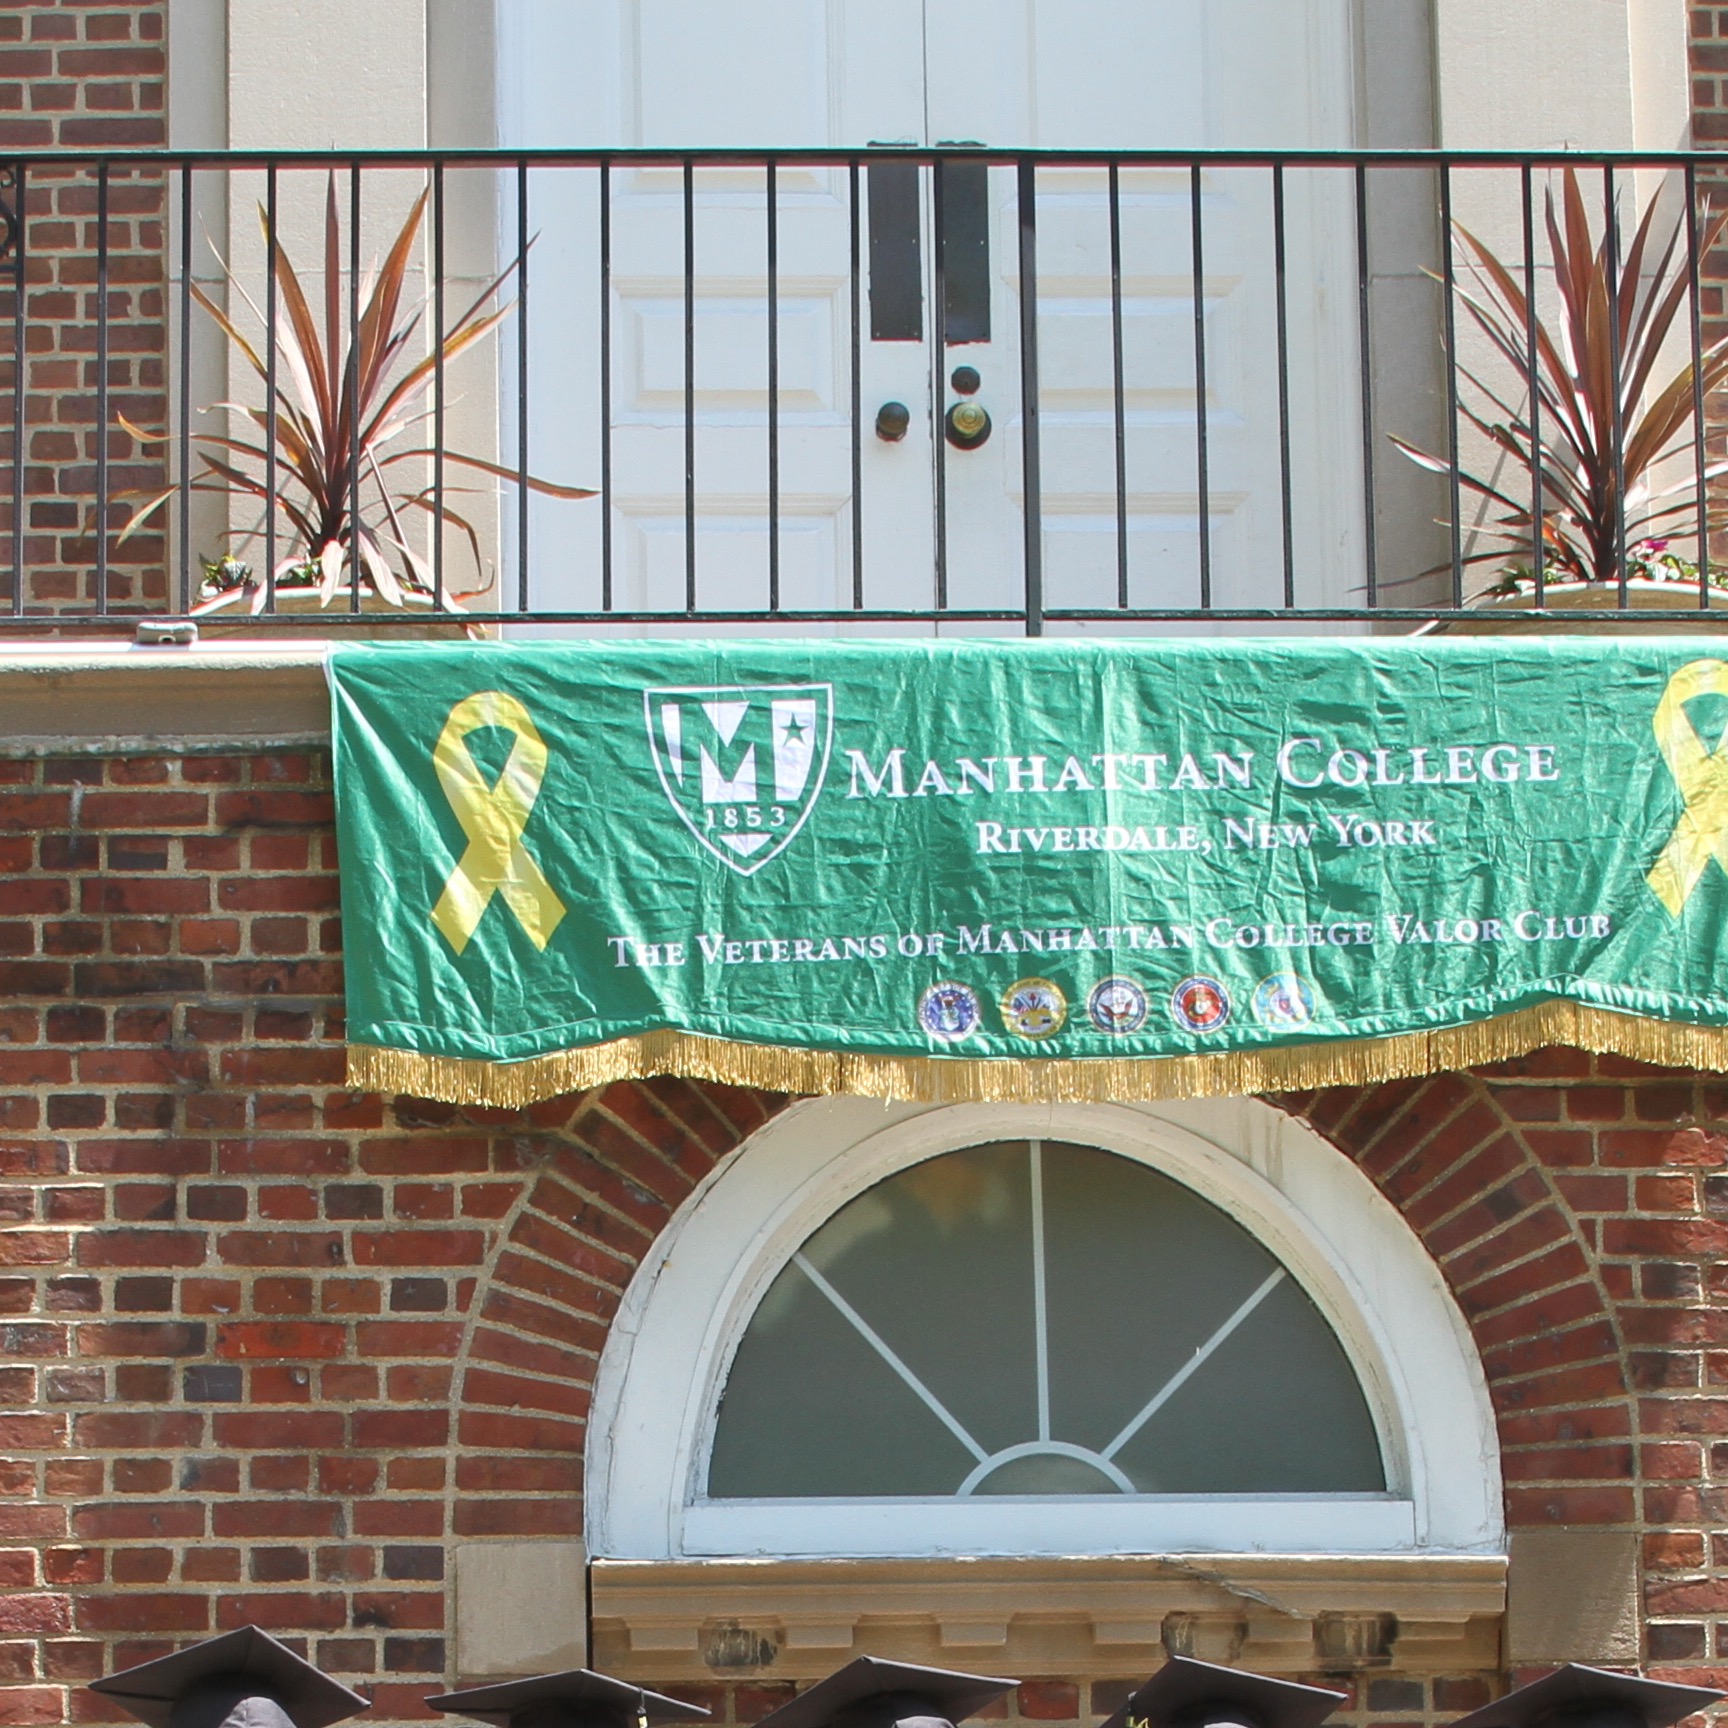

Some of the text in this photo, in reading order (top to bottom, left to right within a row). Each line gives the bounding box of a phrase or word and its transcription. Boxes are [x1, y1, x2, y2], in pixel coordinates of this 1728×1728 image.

[844, 737, 1560, 799] MANHATTAN COLLEGE
[706, 805, 786, 829] 1853
[975, 813, 1437, 856] RIVERDALE, NEW YORK
[606, 908, 1612, 968] THE VETERANS OF MANHATTAN COLLEGE VALOR CLUB
